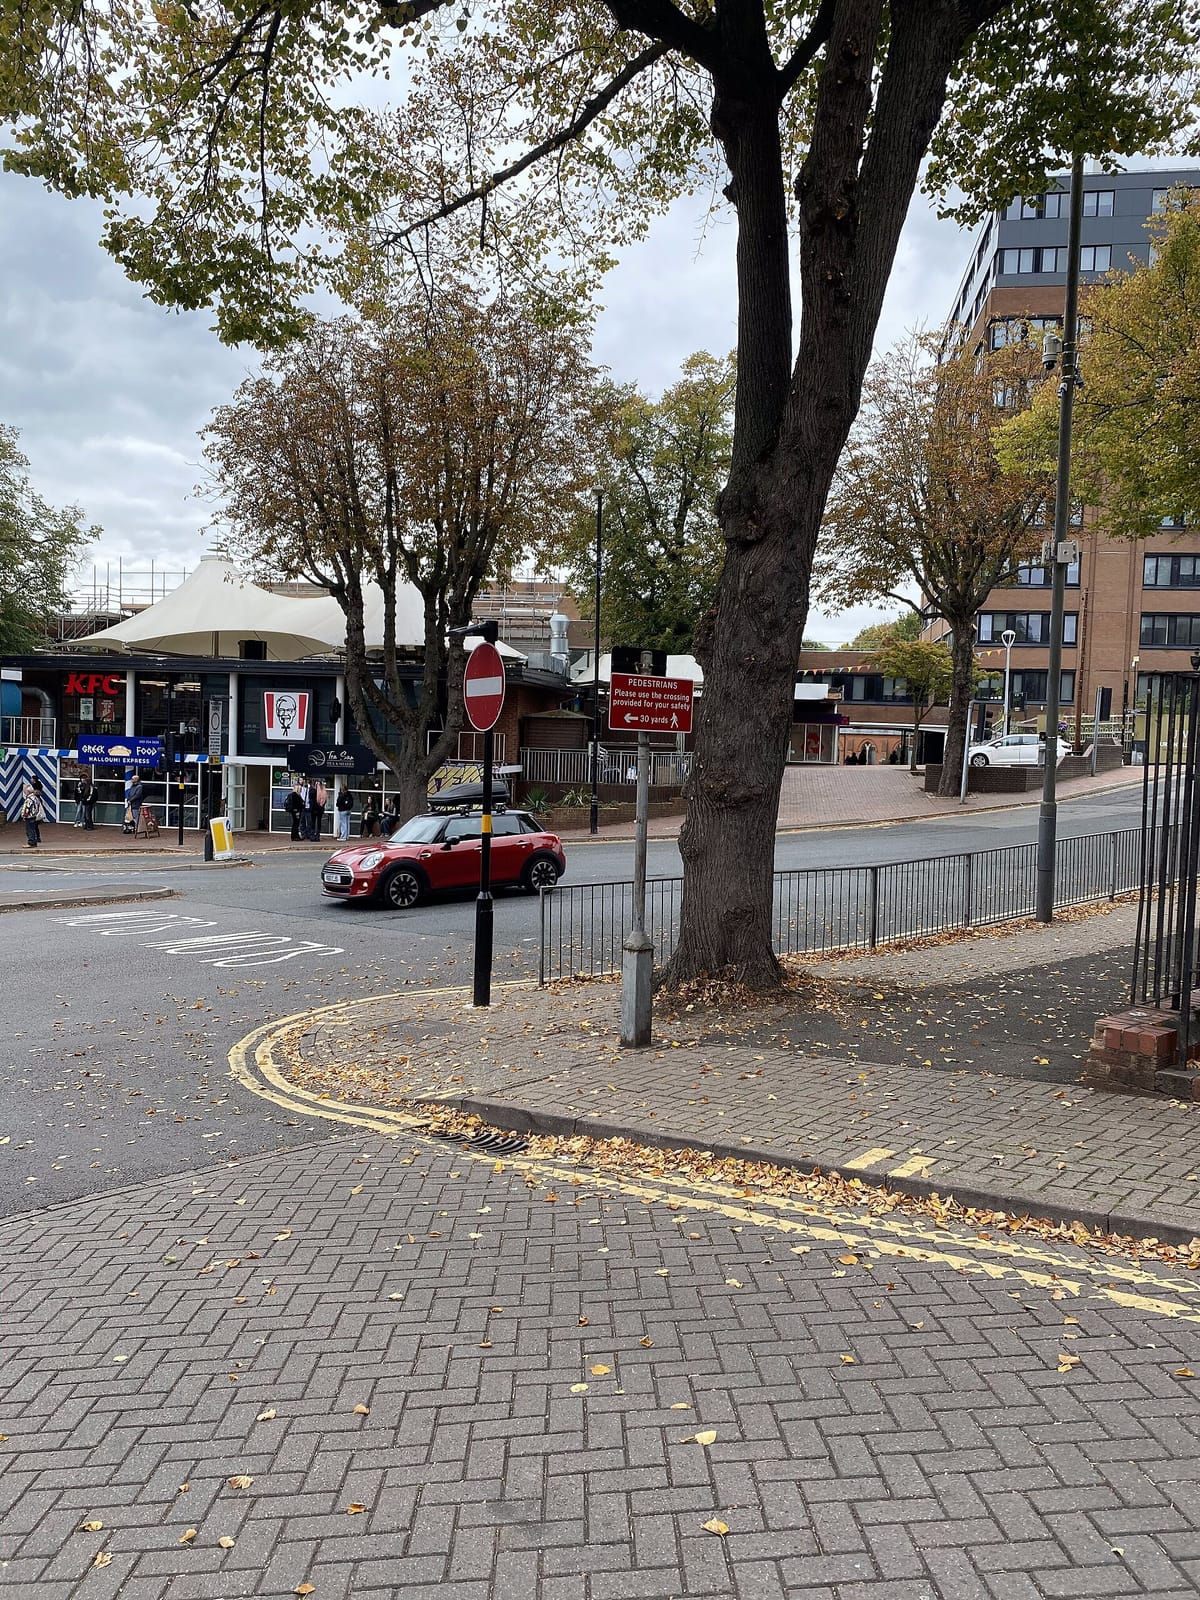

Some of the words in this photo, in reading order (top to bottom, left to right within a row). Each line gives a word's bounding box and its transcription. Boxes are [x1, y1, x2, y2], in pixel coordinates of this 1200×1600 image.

[65, 674, 120, 694] KFC
[628, 678, 678, 689] PEDESTRIANS
[614, 689, 636, 698] Please
[651, 691, 662, 699] the
[663, 694, 690, 702] crossing
[612, 698, 642, 707] provided
[643, 699, 653, 708] for
[655, 702, 669, 710] your
[670, 703, 690, 711] safety
[640, 715, 650, 723] 30
[651, 716, 668, 724] yards
[81, 744, 105, 755] GREEK
[136, 746, 158, 756] FOOD
